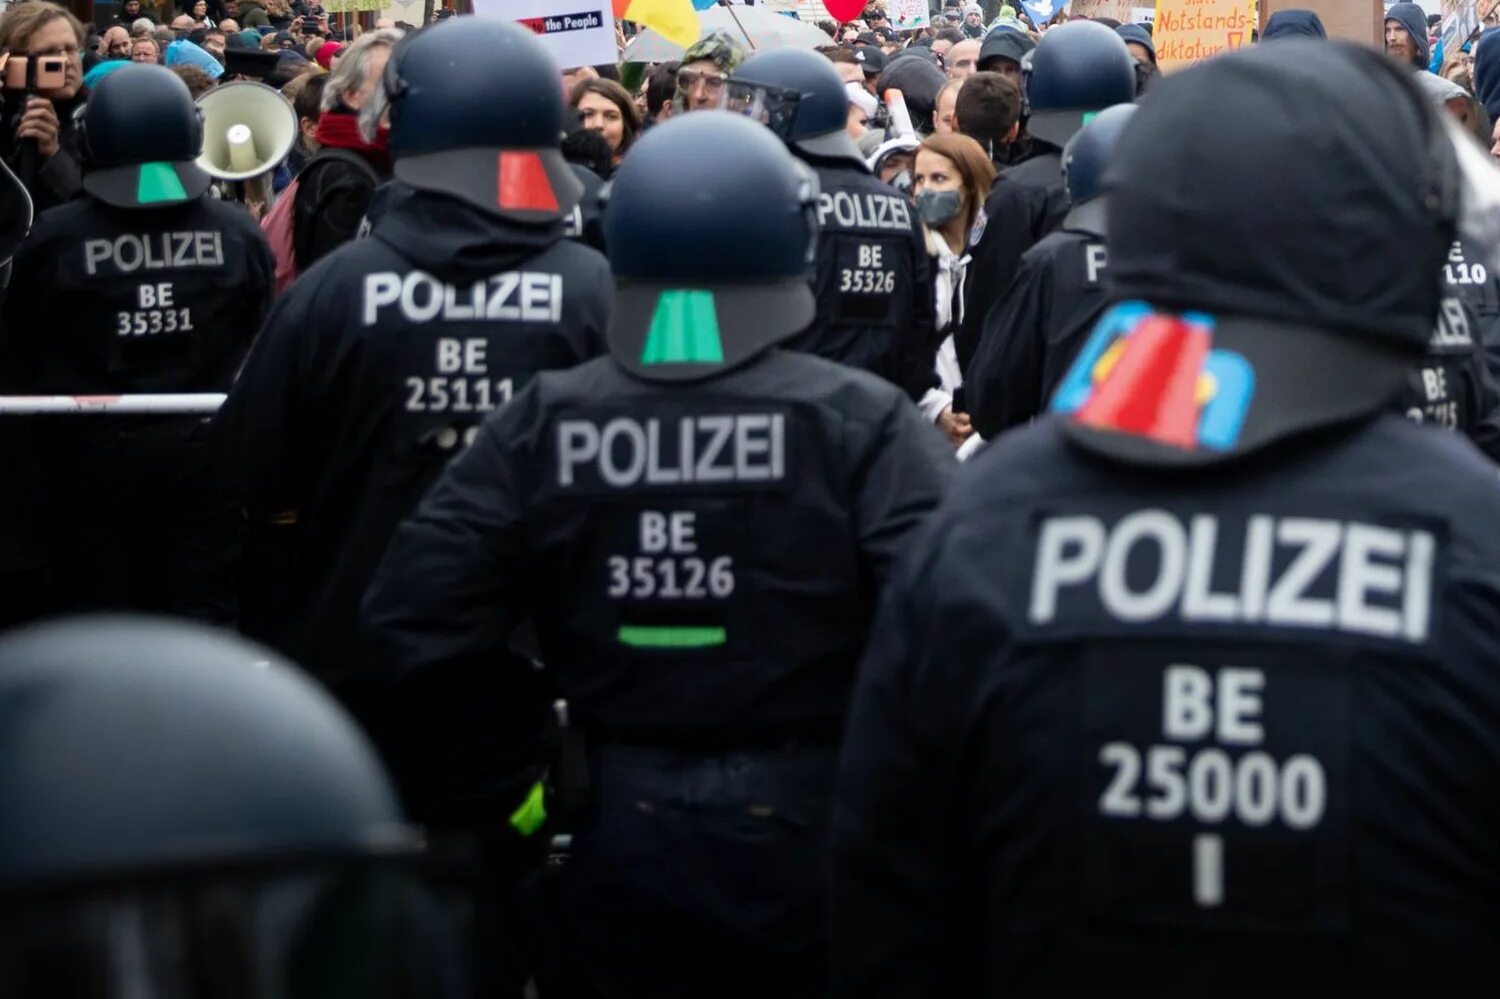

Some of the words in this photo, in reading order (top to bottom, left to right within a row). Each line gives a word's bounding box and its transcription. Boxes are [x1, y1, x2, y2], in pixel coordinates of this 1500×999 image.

[546, 18, 562, 32] the
[564, 13, 597, 31] People
[1157, 7, 1254, 33] Notstands-
[817, 191, 912, 231] POLIZEI
[84, 230, 225, 275] POLIZEI
[858, 244, 883, 268] BE
[139, 282, 174, 309] BE
[363, 269, 563, 325] POLIZEI
[839, 268, 896, 294] 35326
[117, 307, 194, 336] 35331
[437, 337, 488, 374] BE
[405, 376, 514, 412] 25111
[557, 412, 786, 488] POLIZEI
[640, 510, 698, 554] BE
[607, 554, 736, 598] 35126
[1028, 507, 1437, 643] POLIZEI
[1163, 664, 1266, 745] BE
[1100, 741, 1328, 831] 25000
